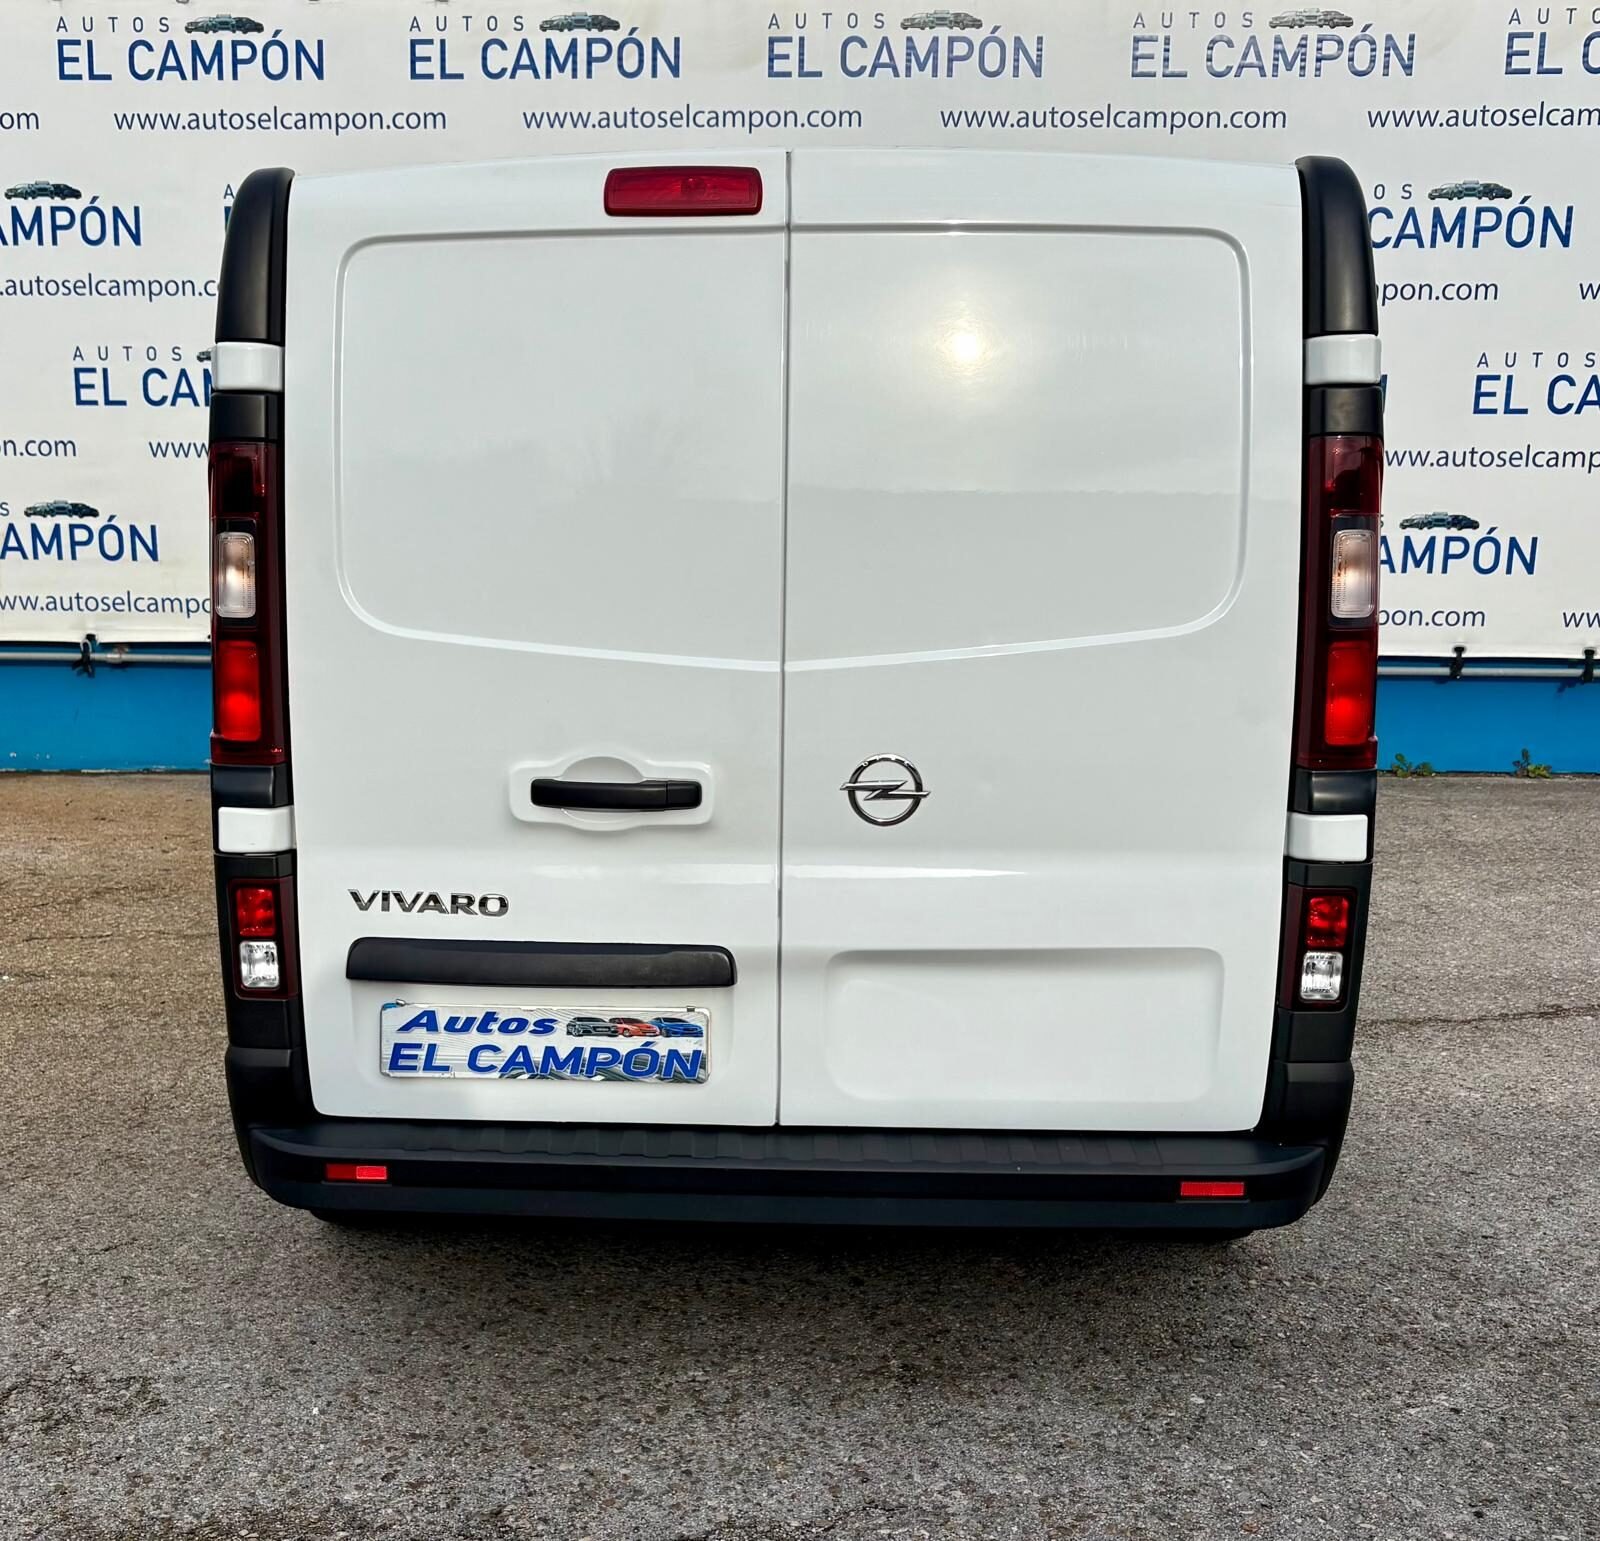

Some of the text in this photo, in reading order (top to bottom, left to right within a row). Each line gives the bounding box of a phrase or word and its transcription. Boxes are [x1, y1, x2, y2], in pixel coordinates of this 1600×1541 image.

[56, 16, 169, 32] AUTOS
[410, 16, 523, 32] AUTOS
[768, 13, 884, 29] AUTOS
[1133, 12, 1252, 28] AUTOS
[57, 29, 324, 81] EL CAMPÓN
[410, 27, 680, 80] EL CAMPÓN
[768, 25, 1043, 78] EL CAMPÓN
[1131, 24, 1415, 78] EL CAMPÓN
[1505, 32, 1563, 75] EL
[114, 106, 446, 136] www.autoselcampon.com
[523, 104, 861, 134] www.autoselcampon.com
[940, 104, 1286, 135] www.autoselcampon.com
[1368, 195, 1573, 249] CAMPÓN
[73, 346, 181, 361] AUTOS
[1477, 352, 1595, 368] AUTOS
[74, 367, 211, 407] EL CA
[1473, 375, 1528, 414] EL
[0, 440, 76, 456] n.com
[0, 515, 159, 562] AMPÓN
[347, 888, 509, 917] VIVARO
[396, 1009, 559, 1035] Autos
[388, 1040, 703, 1079] EL CAMPÓN
